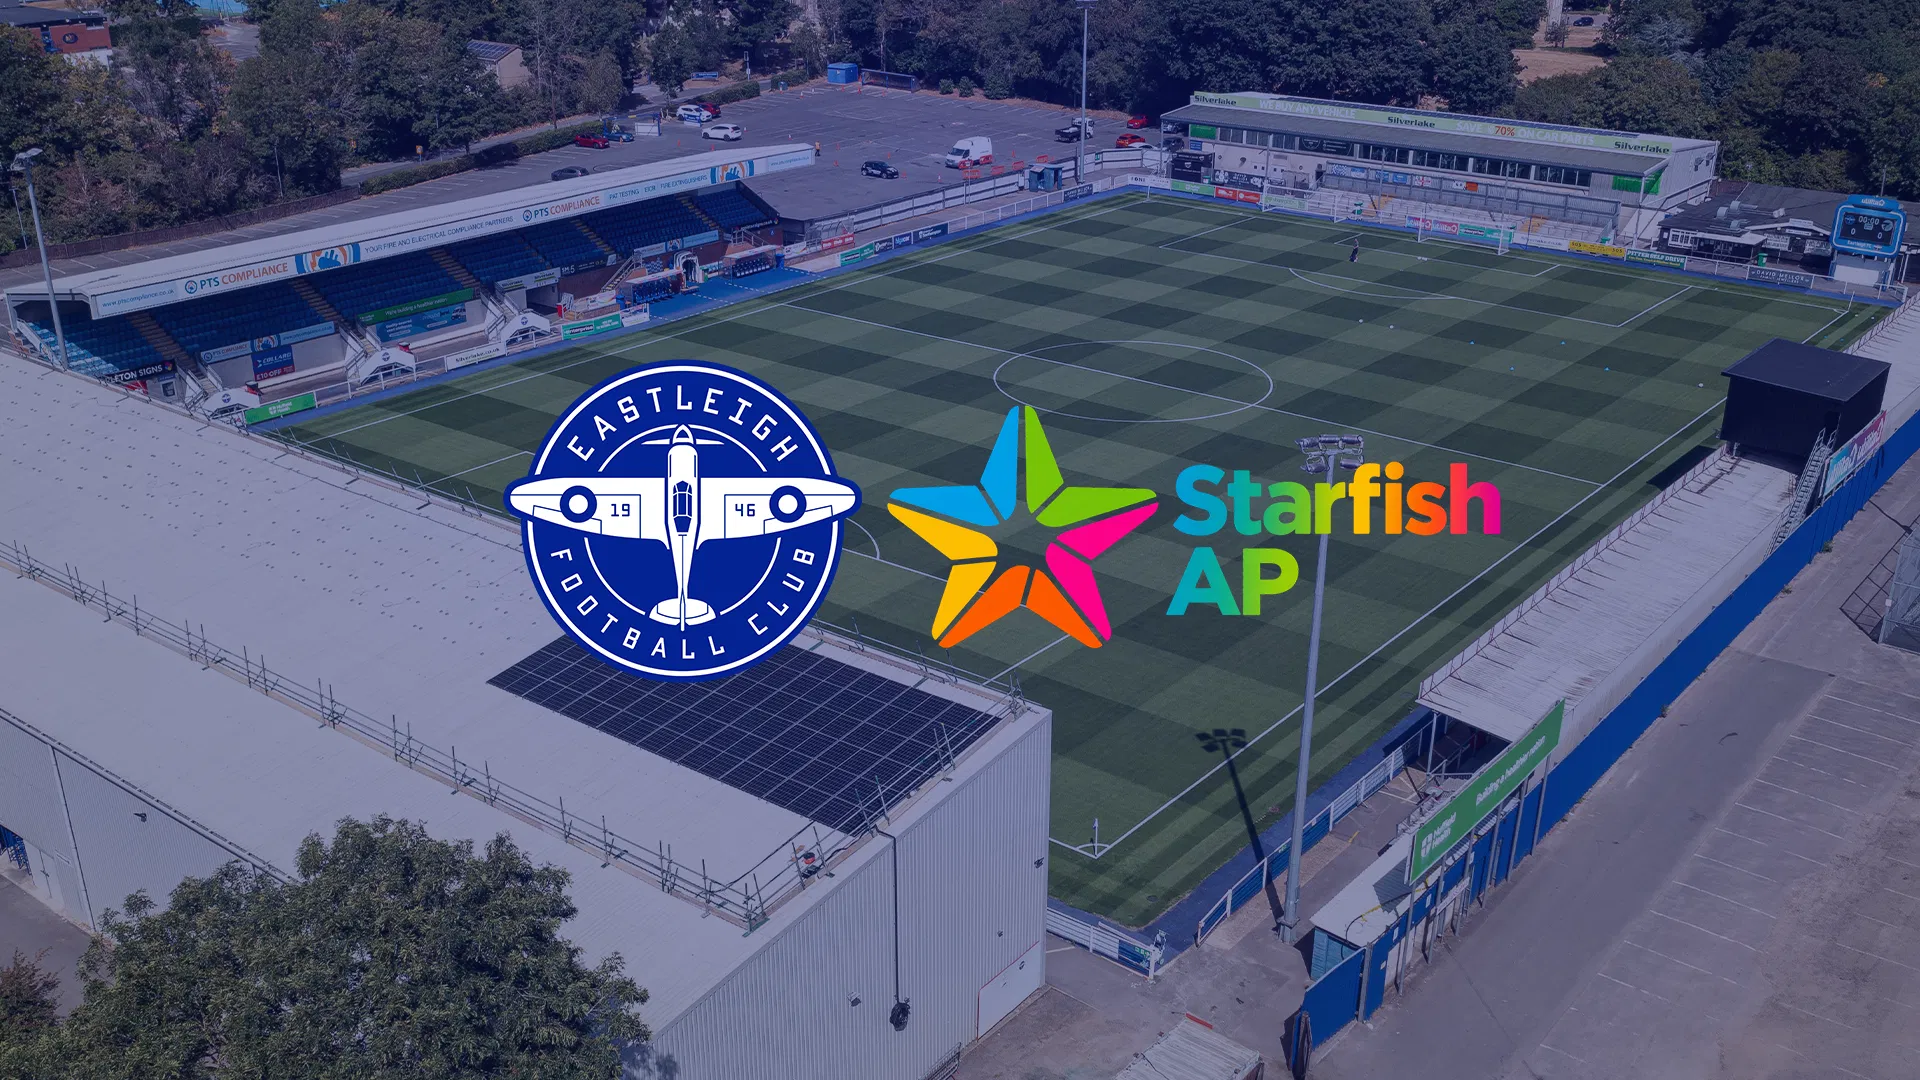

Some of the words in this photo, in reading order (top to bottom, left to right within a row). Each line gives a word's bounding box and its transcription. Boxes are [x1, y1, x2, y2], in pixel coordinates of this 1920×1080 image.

[1194, 94, 1237, 106] Silverlake
[1259, 100, 1275, 110] WE
[1275, 101, 1295, 112] BUY
[1295, 103, 1316, 115] ANY
[1316, 105, 1357, 119] VEHICLE
[1387, 116, 1435, 128] Silverlake
[1456, 121, 1482, 133] SAVE
[1495, 126, 1515, 137] 70%
[1517, 129, 1535, 139] ON
[1536, 131, 1559, 142] CAR
[1559, 134, 1595, 146] PARTS
[1614, 141, 1670, 154] Silverlake
[618, 188, 640, 198] TESTING
[534, 207, 549, 218] PTS
[550, 195, 600, 215] COMPLIANCE
[365, 243, 383, 253] YOUR
[398, 238, 411, 247] AND
[412, 230, 447, 244] ELECTRICAL
[447, 222, 484, 235] COMPLIANCE
[485, 215, 514, 227] PARTNERS
[200, 276, 220, 290] PTS
[221, 262, 289, 285] COMPLIANCE
[1756, 269, 1776, 277] DAVID
[138, 364, 163, 376] SIGNS
